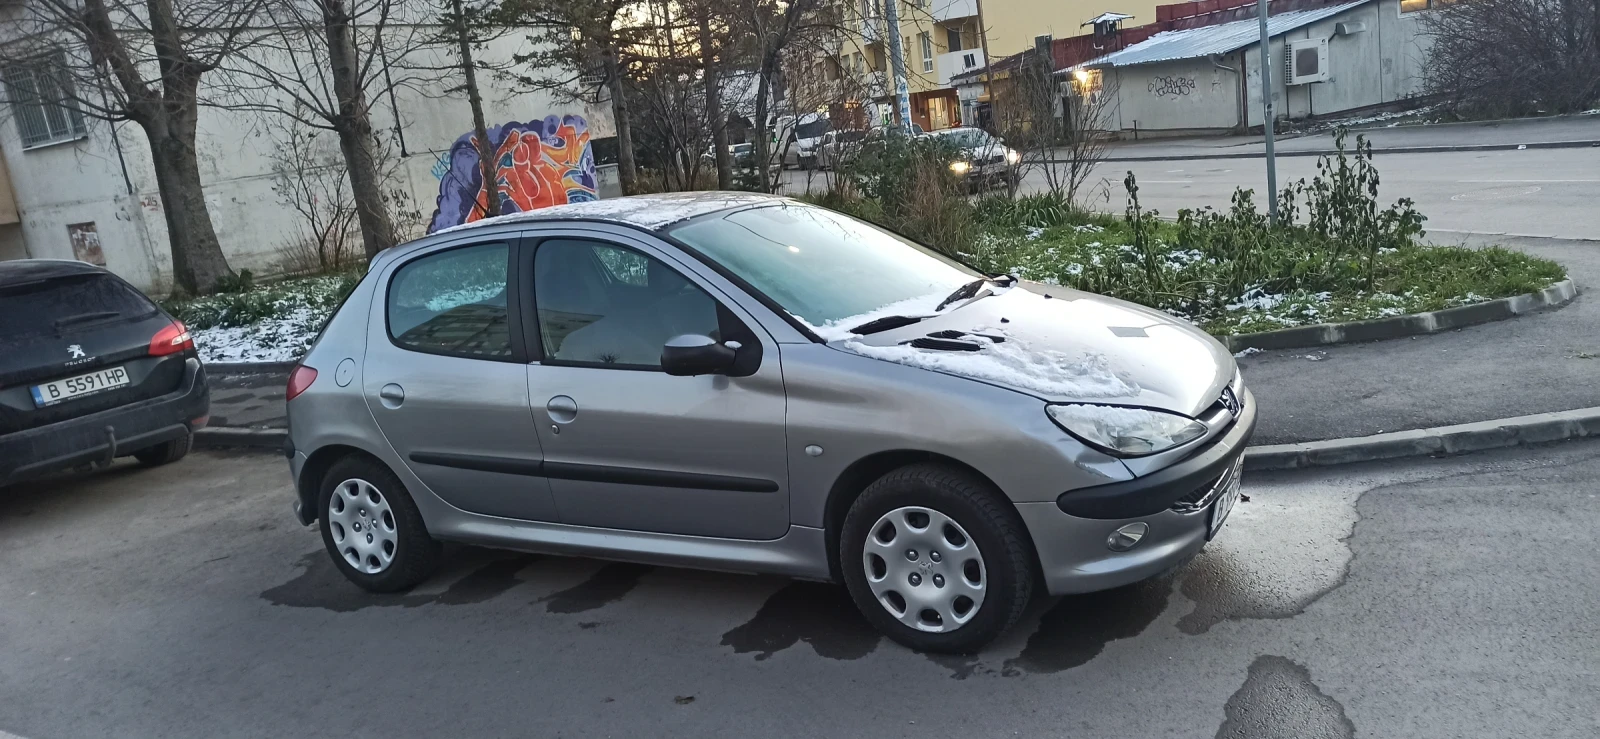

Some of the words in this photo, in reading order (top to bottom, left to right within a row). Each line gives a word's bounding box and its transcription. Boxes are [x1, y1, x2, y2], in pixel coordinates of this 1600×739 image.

[47, 383, 61, 399] B
[65, 373, 104, 394] 5591
[104, 368, 125, 385] HP
